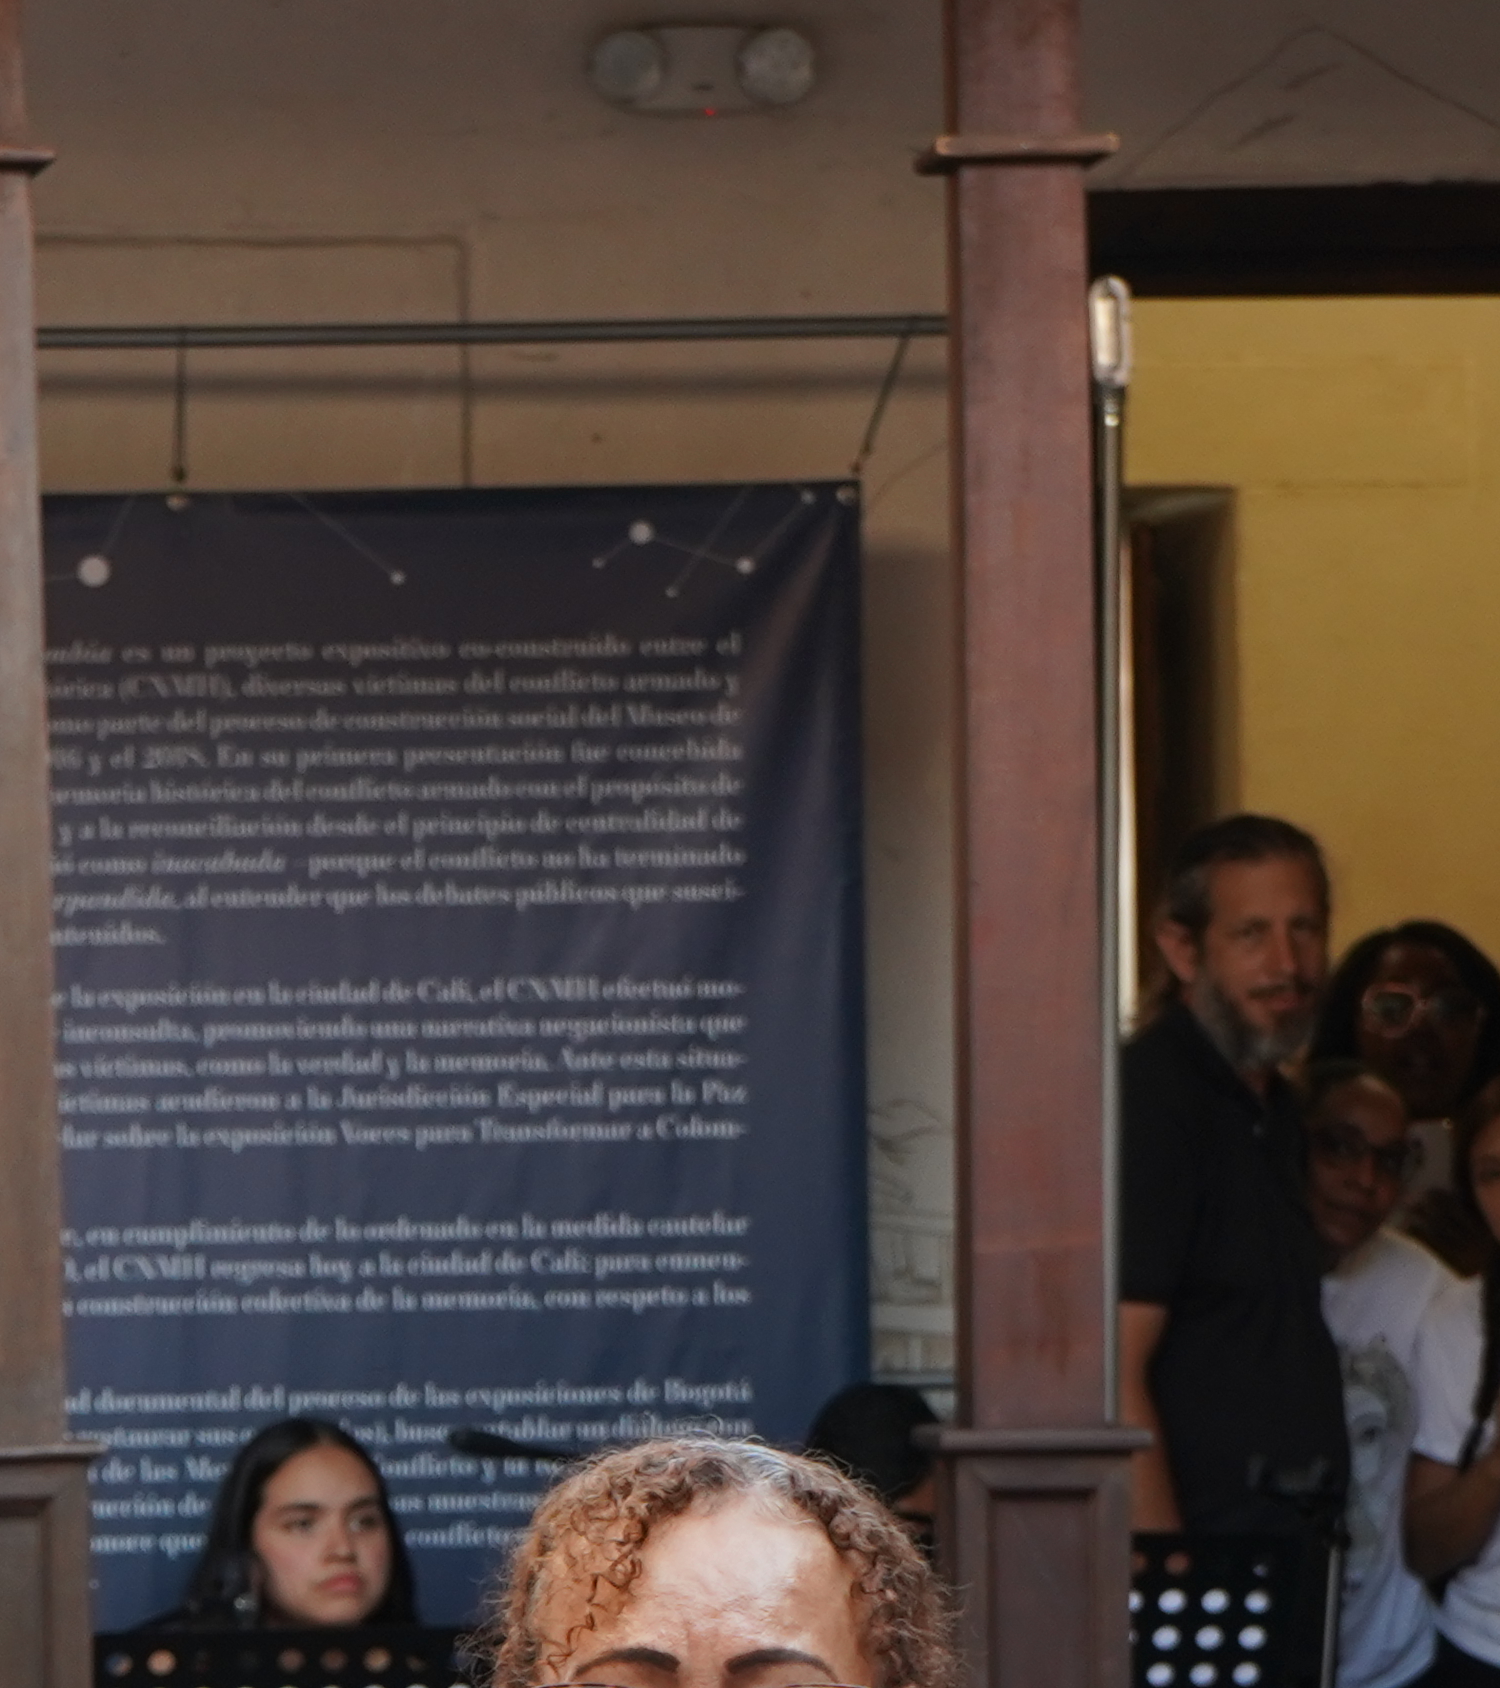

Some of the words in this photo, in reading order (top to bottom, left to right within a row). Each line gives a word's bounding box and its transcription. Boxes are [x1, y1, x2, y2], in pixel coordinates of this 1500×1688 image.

[715, 631, 743, 657] el
[463, 670, 505, 695] del
[165, 709, 208, 733] del
[580, 704, 623, 728] del
[87, 753, 102, 777] y
[108, 745, 135, 769] el
[217, 743, 254, 768] En
[262, 778, 303, 803] del
[561, 774, 588, 798] el
[305, 813, 380, 838] desde
[382, 812, 410, 836] el
[399, 847, 426, 871] el
[325, 890, 372, 914] que
[294, 980, 381, 1005] ciudad
[382, 980, 414, 1004] de
[479, 977, 506, 1002] el
[699, 1015, 747, 1040] que
[296, 1050, 383, 1075] verdad
[385, 1057, 401, 1081] y
[306, 1086, 333, 1110] la
[497, 1081, 604, 1113] Especial
[607, 1087, 666, 1112] para
[701, 1079, 748, 1104] Paz
[102, 1123, 173, 1148] sobre
[414, 1125, 474, 1150] para
[478, 1117, 633, 1143] Transformar
[299, 1218, 331, 1242] de
[550, 1213, 645, 1239] medida
[83, 1255, 111, 1281] el
[112, 1254, 206, 1280] CNMH
[309, 1253, 353, 1283] hoy
[407, 1250, 493, 1276] ciudad
[493, 1250, 527, 1274] de
[594, 1254, 652, 1280] para
[355, 1287, 387, 1312] de
[391, 1286, 418, 1311] la
[243, 1385, 286, 1411] del
[388, 1383, 420, 1408] de
[626, 1379, 658, 1404] de
